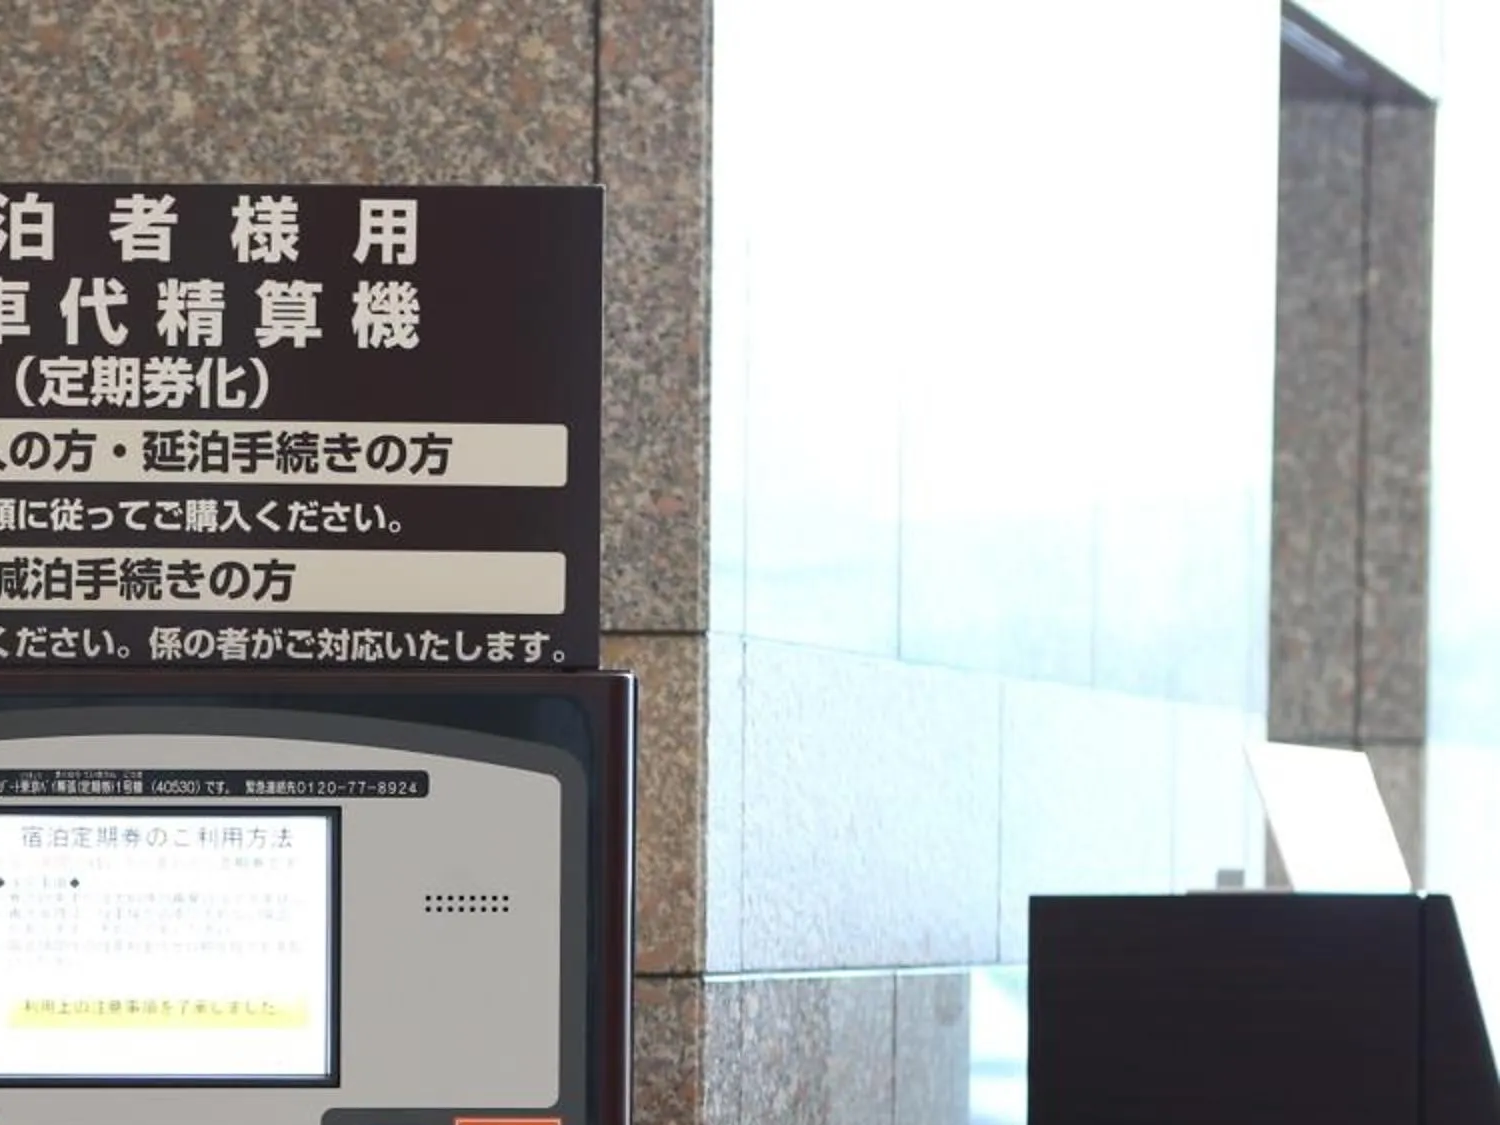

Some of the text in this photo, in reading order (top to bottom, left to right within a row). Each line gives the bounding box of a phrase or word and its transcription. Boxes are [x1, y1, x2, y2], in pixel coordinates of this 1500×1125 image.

[21, 826, 293, 849] 宿泊定期券のご利用方法
